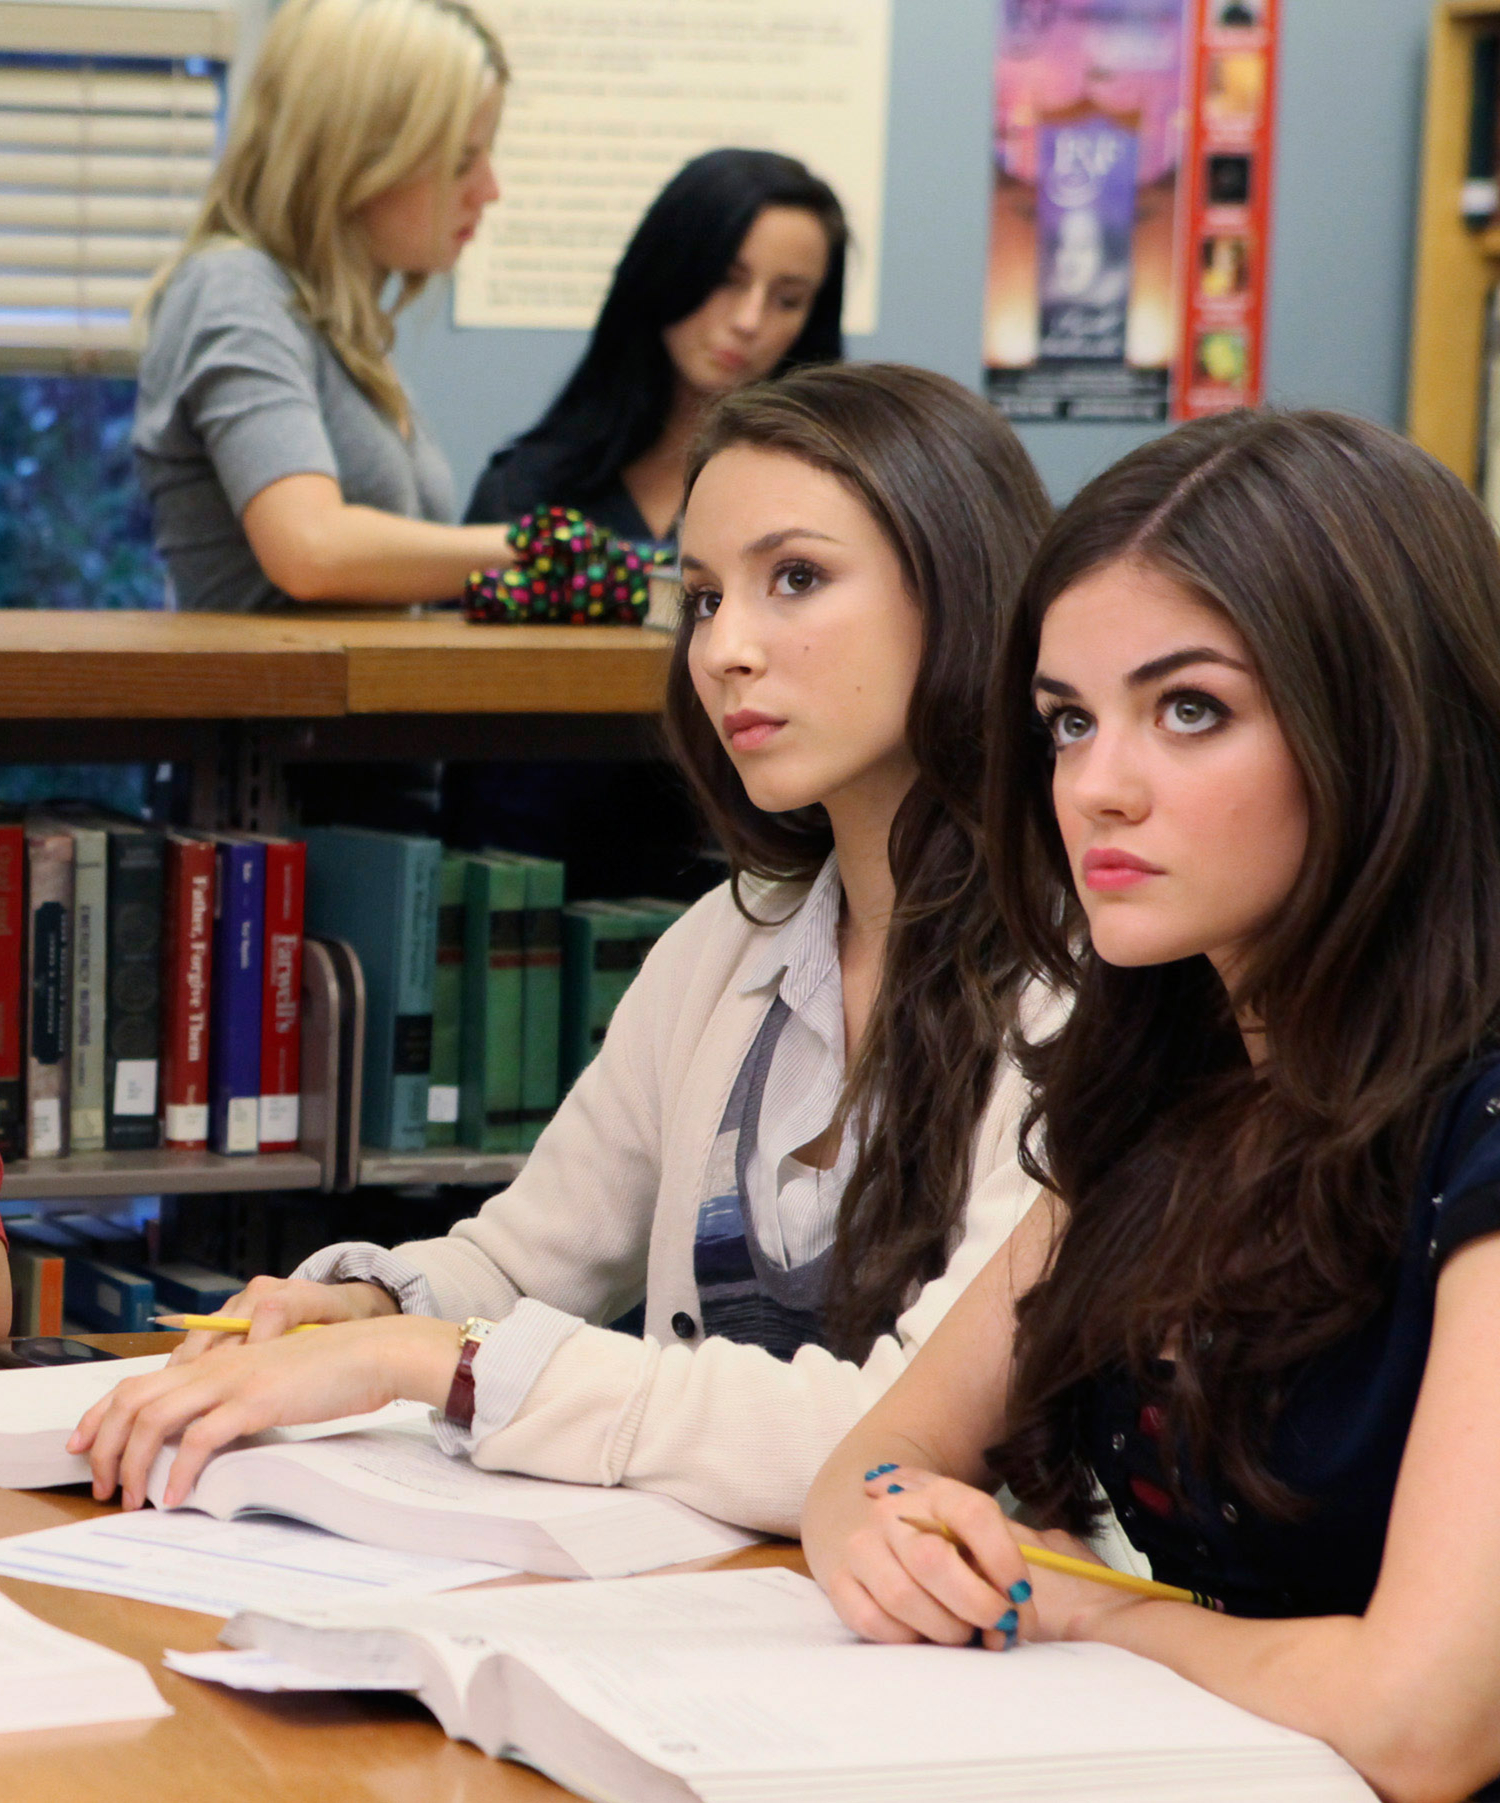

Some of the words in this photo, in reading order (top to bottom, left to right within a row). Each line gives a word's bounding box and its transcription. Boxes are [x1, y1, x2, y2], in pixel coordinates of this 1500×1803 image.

[190, 874, 208, 939] Father,
[186, 941, 208, 1008] Forgive
[276, 933, 299, 1034] Farwell's
[188, 1012, 205, 1062] Them
